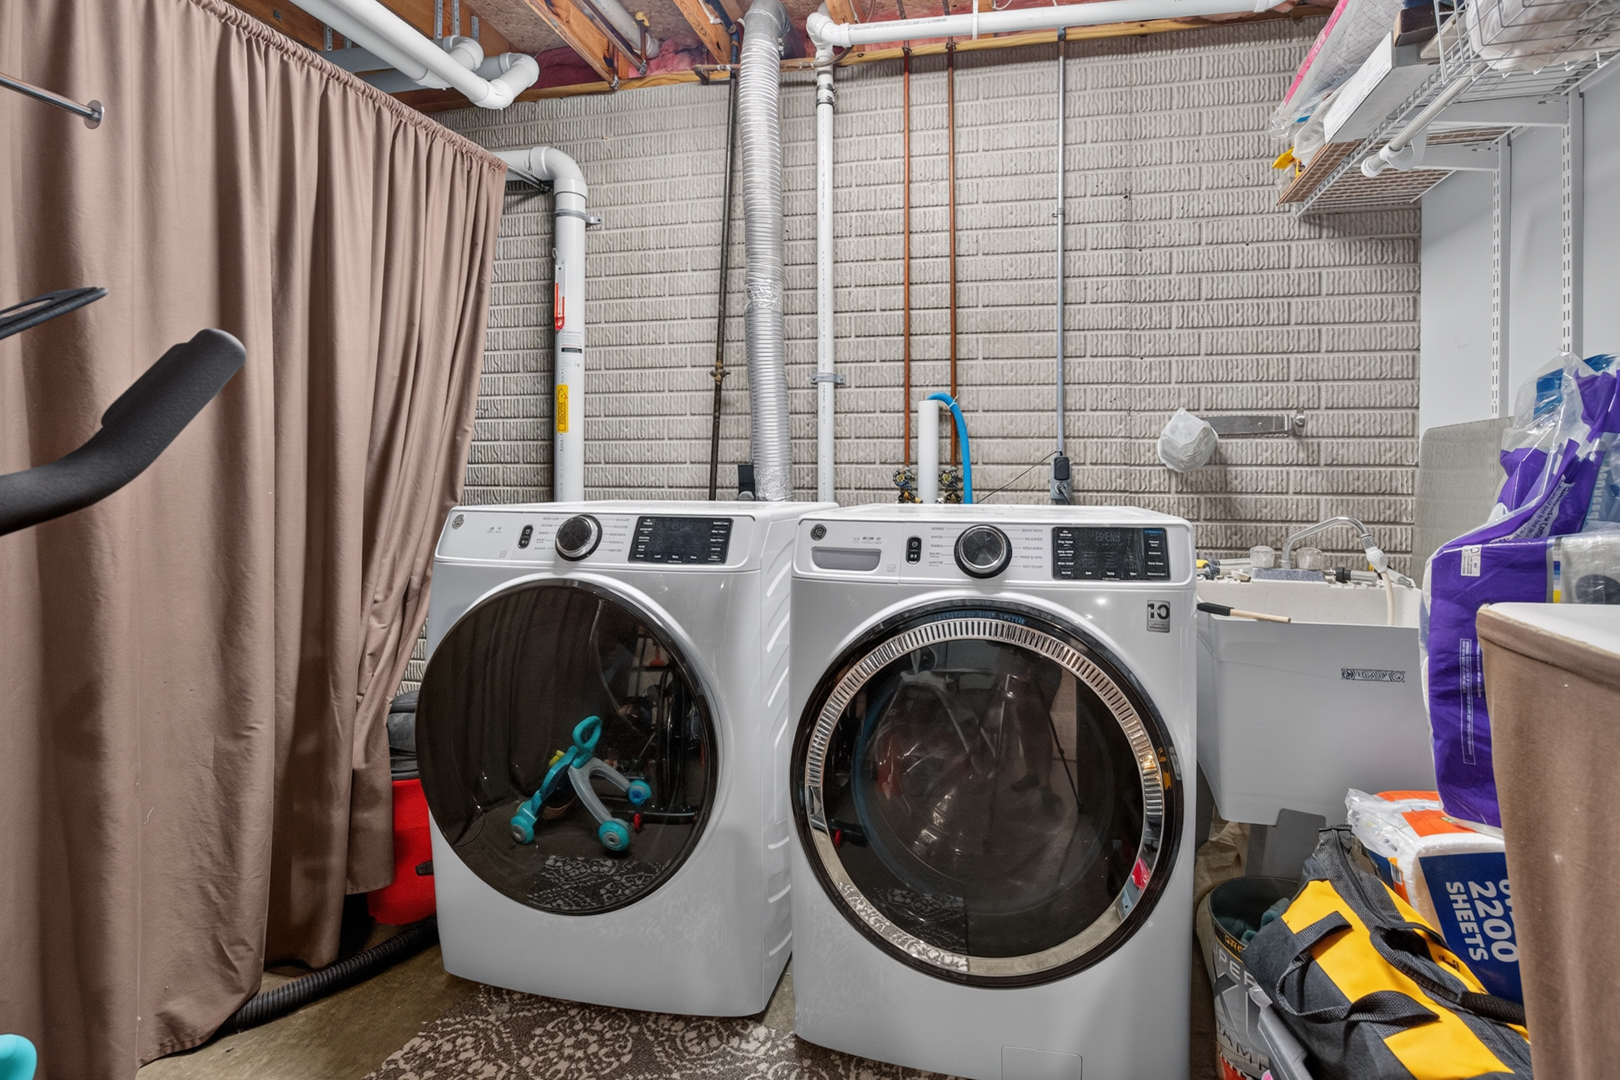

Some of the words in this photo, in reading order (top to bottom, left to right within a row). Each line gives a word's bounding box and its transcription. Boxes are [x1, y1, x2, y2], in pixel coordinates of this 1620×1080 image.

[1148, 603, 1170, 620] 10
[1445, 881, 1490, 962] SHEETS
[1467, 880, 1520, 963] 2200
